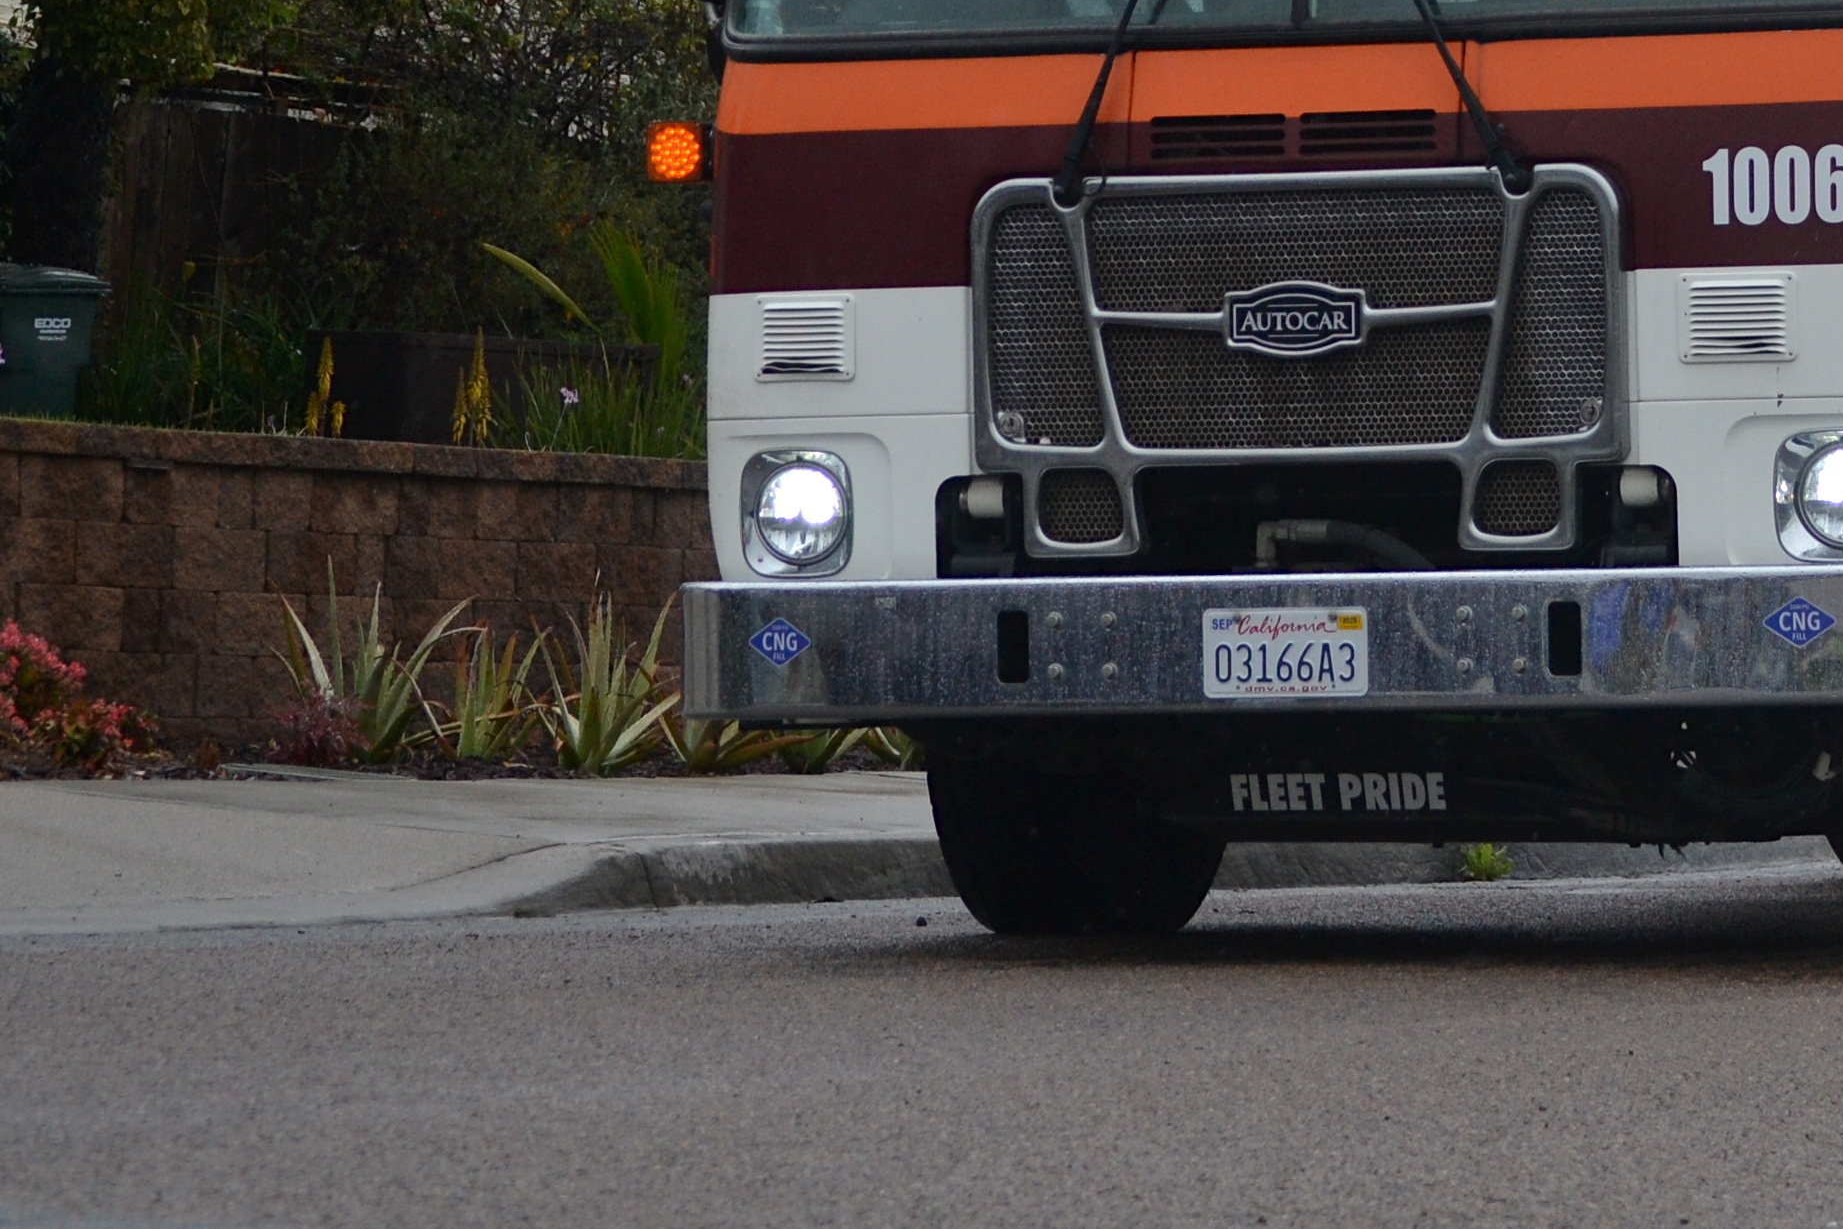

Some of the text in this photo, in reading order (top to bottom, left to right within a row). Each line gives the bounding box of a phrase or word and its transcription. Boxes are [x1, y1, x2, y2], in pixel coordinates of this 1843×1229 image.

[35, 318, 71, 328] EDCO
[1239, 310, 1349, 333] AUTOCAR
[1211, 617, 1233, 631] SEP
[1237, 614, 1337, 641] California
[1779, 612, 1820, 631] CNG
[762, 632, 798, 651] CNG
[1793, 632, 1806, 640] FILL
[1214, 642, 1356, 684] 03166A3
[1244, 684, 1328, 694] dmv.ca.gov
[1229, 771, 1447, 812] FLEET PRIDE
